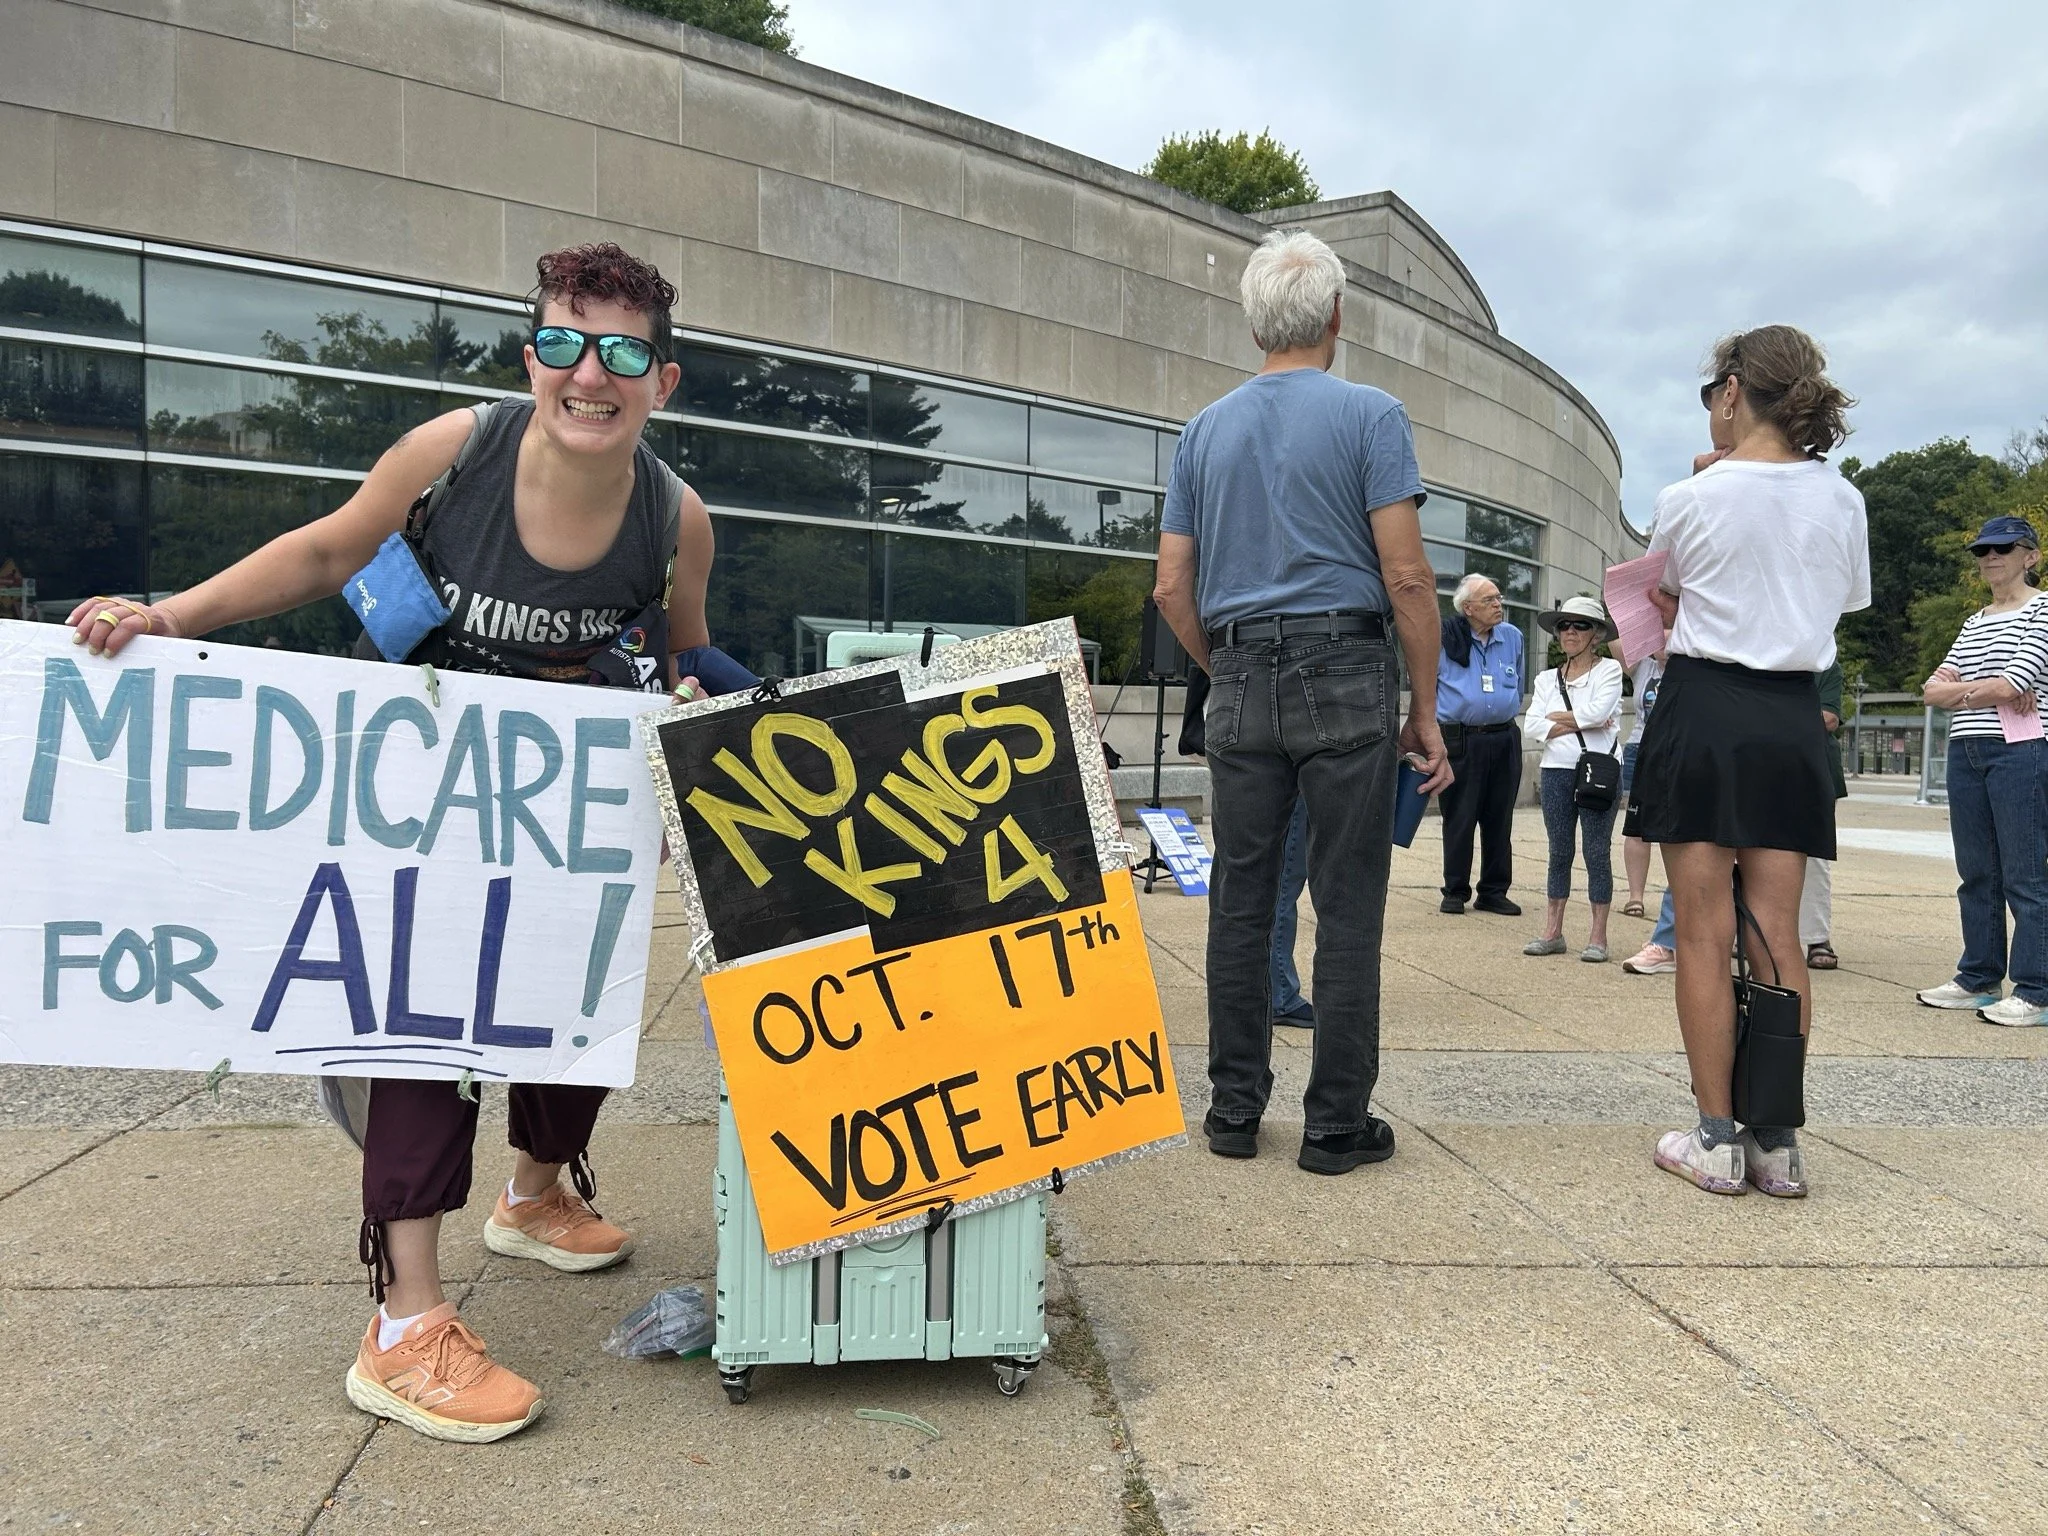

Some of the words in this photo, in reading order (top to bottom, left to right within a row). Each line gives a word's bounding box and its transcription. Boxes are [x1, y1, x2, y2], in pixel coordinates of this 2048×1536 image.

[439, 576, 461, 612] O
[463, 592, 571, 644] KINGS
[579, 608, 627, 642] DAY
[609, 647, 634, 667] AUTISTIC
[22, 657, 636, 874] MEDICARE
[686, 711, 858, 889] NO
[803, 685, 1057, 919] KINGS
[984, 813, 1070, 905] 4
[43, 919, 226, 1010] FOR
[250, 862, 636, 1048] ALL!
[753, 952, 935, 1066] OCT.
[988, 911, 1121, 1010] 17th
[771, 1071, 1003, 1211] VOTE
[1016, 1031, 1167, 1149] EARLY
